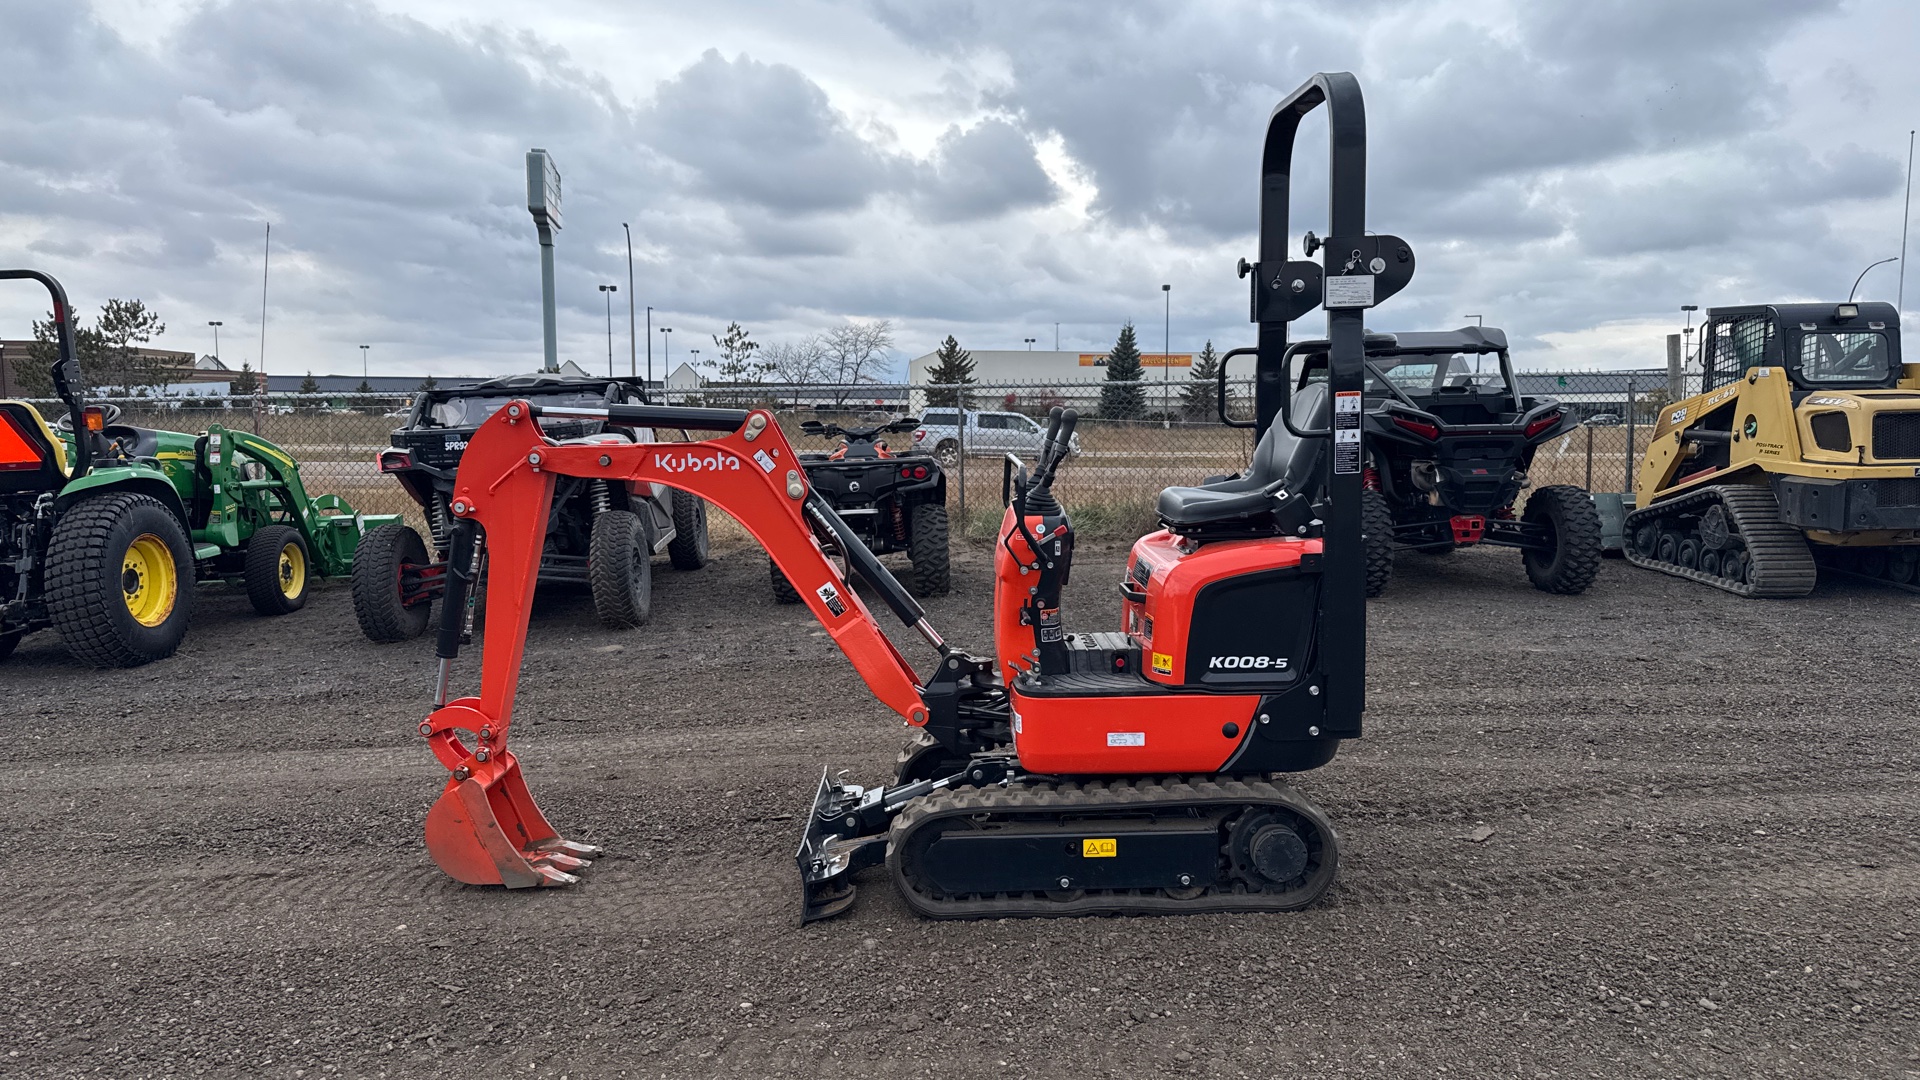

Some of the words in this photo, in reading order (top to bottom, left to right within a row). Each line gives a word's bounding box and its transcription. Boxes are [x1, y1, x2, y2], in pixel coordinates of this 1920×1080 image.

[1707, 387, 1736, 406] RC-60
[1672, 407, 1687, 420] POSI
[654, 451, 740, 473] Kubota
[1208, 656, 1289, 669] K008-5
